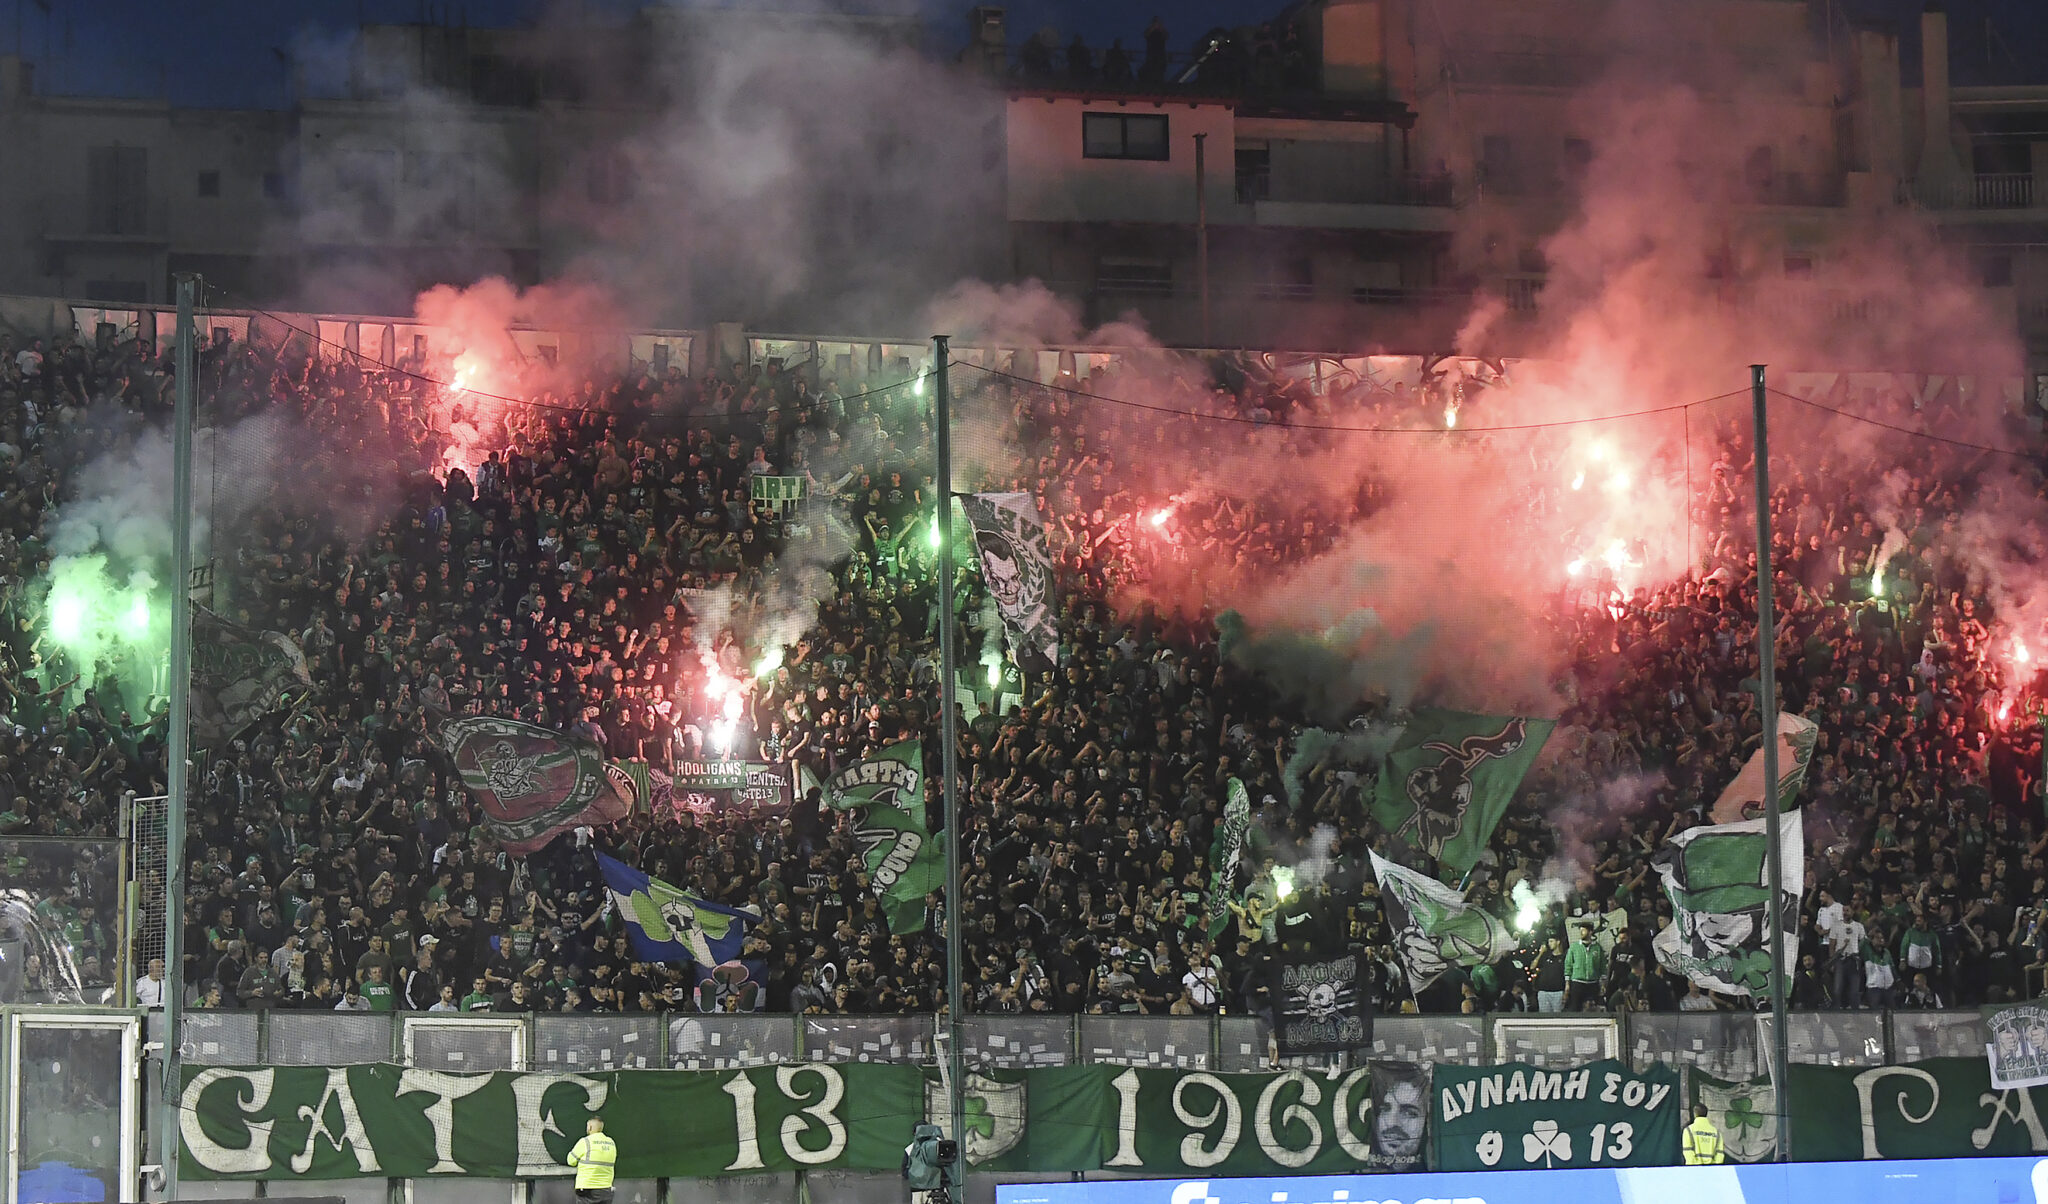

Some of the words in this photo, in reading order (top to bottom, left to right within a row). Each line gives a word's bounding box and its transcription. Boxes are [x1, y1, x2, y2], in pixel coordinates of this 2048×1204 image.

[677, 760, 741, 776] HOOLIGANS
[1442, 1069, 1590, 1122] ΔΥΝΑΜΗ
[1600, 1072, 1670, 1111] ΣΟΥ
[180, 1067, 607, 1176] GATE
[721, 1064, 848, 1171] 13
[1590, 1122, 1633, 1162] 13
